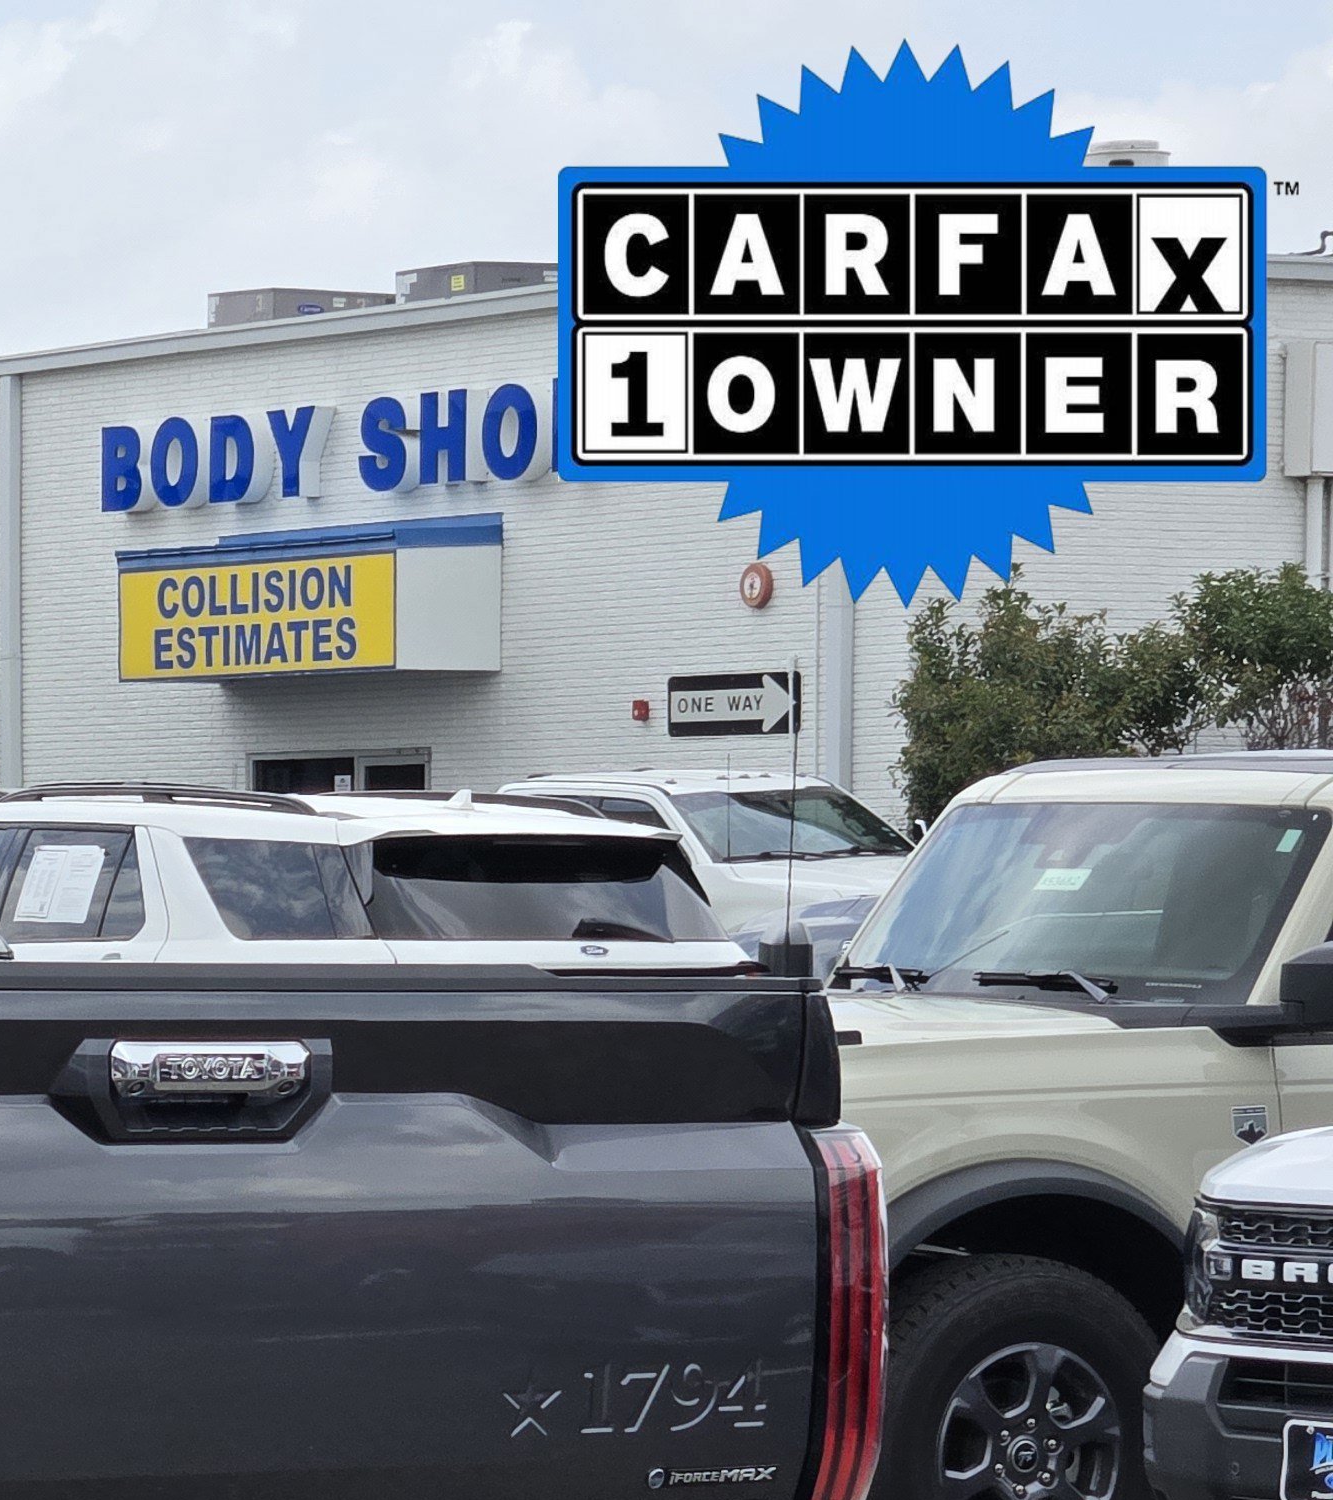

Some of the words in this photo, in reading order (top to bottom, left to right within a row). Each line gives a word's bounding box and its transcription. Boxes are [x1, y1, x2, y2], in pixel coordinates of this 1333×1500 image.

[101, 405, 316, 513] BODY
[358, 377, 558, 492] SHO
[157, 565, 353, 619] COLLISION
[153, 617, 357, 669] ESTIMATES
[677, 696, 715, 714] ONE
[727, 694, 764, 712] WAY
[167, 1056, 261, 1080] TOYOTA
[1242, 1259, 1333, 1284] BR
[580, 1359, 770, 1434] 1794
